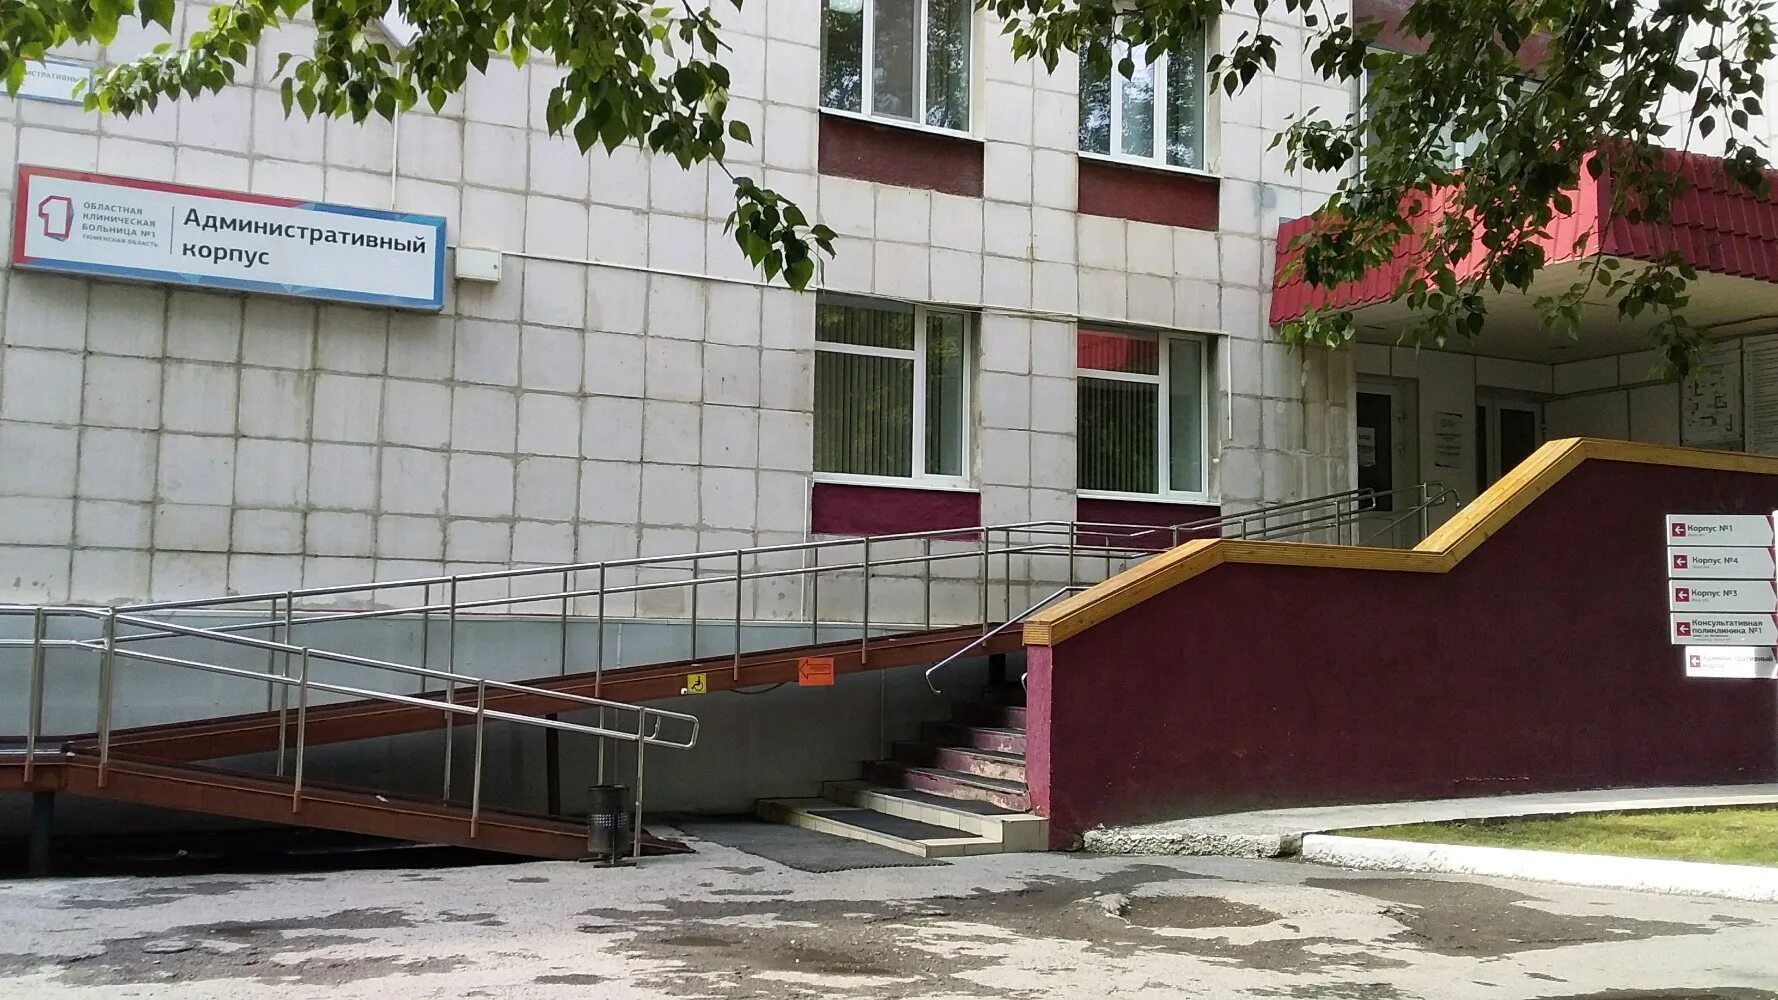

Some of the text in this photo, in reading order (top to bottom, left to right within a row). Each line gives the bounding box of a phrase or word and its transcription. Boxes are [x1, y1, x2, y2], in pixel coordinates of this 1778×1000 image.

[27, 70, 81, 83] СТРАТИВНЫ
[83, 201, 143, 215] ОБЛАСТНАЯ
[82, 212, 156, 227] КЛИНИЧЕСКАЯ
[82, 223, 155, 238] БОЛЬНИЦА №1
[183, 207, 426, 254] Административный
[182, 242, 270, 268] корпус
[1687, 524, 1733, 533] Корпус №1
[1692, 556, 1722, 565] Корпус
[1691, 589, 1738, 598] Корпус №3
[1692, 619, 1763, 628] Консультативная
